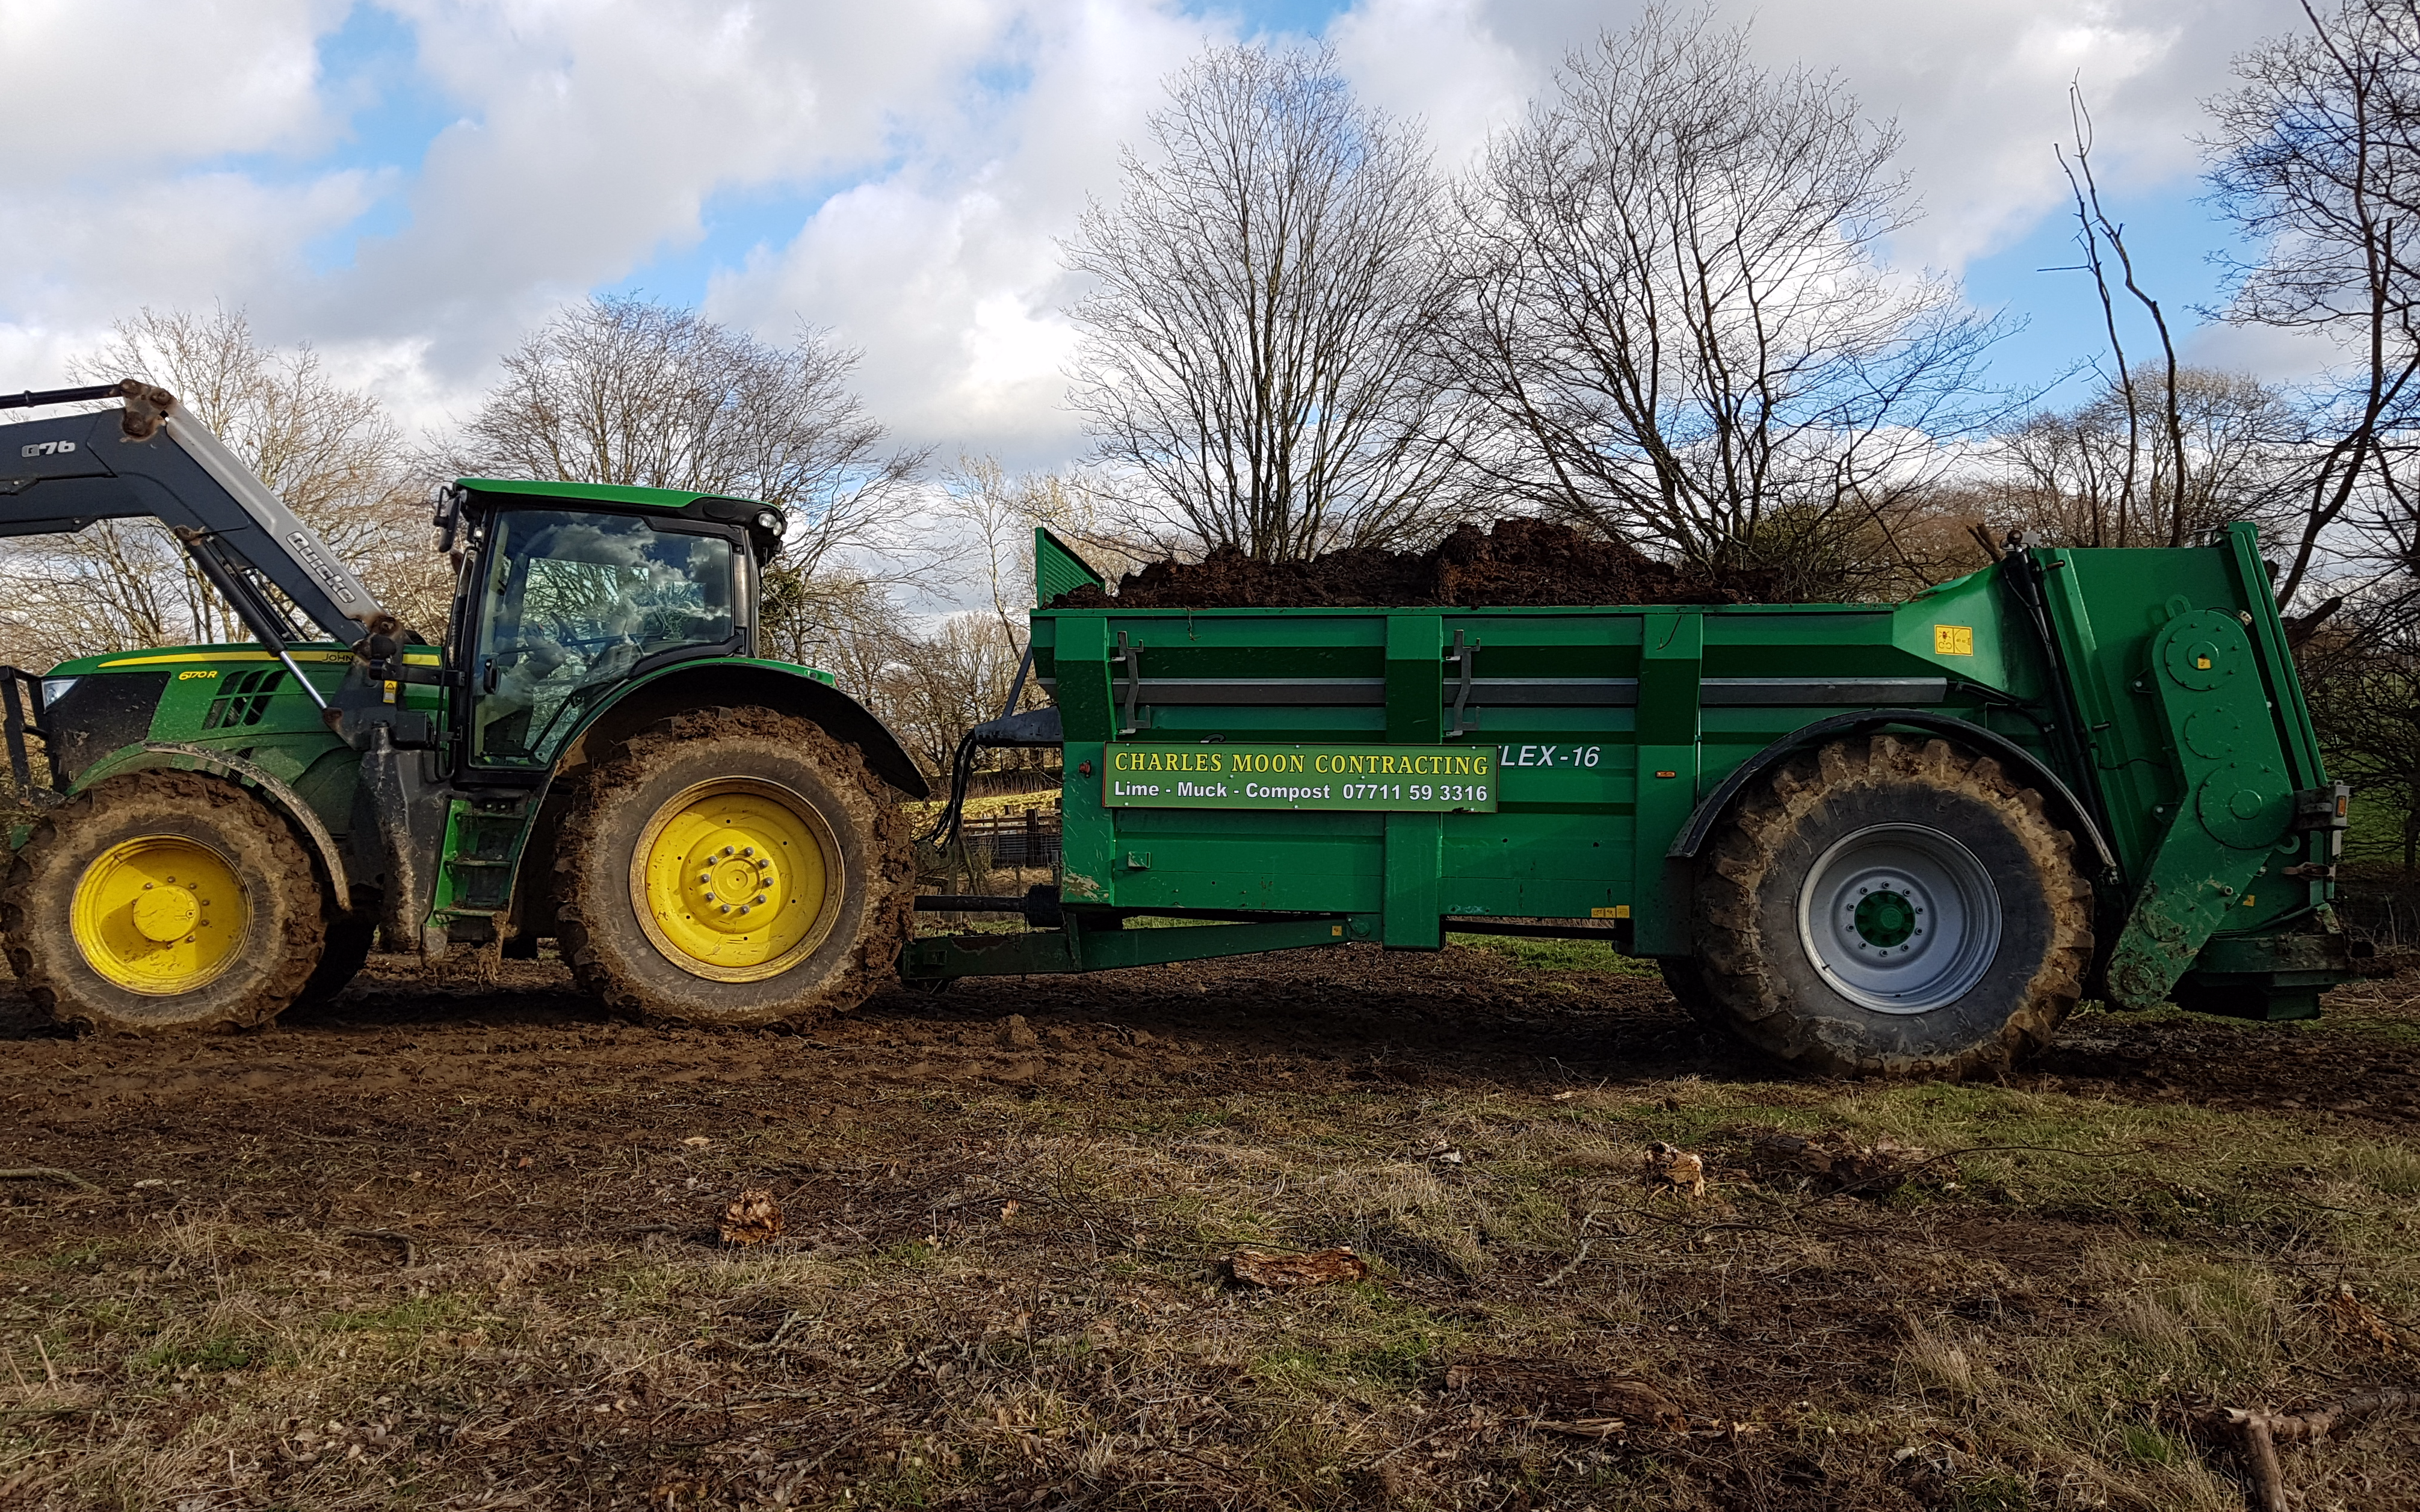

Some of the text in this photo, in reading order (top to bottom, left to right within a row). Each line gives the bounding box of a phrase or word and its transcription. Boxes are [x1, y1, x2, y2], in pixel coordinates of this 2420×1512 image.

[1114, 752, 1489, 776] CHARLES MOON CONTRACTING
[1498, 745, 1600, 768] LEX-16
[1114, 780, 1160, 797] Lime
[1177, 782, 1228, 798] Muck
[1245, 782, 1331, 802] Compost
[1342, 783, 1401, 800] 07711
[1408, 785, 1433, 801] 59
[1439, 785, 1488, 802] 3316
